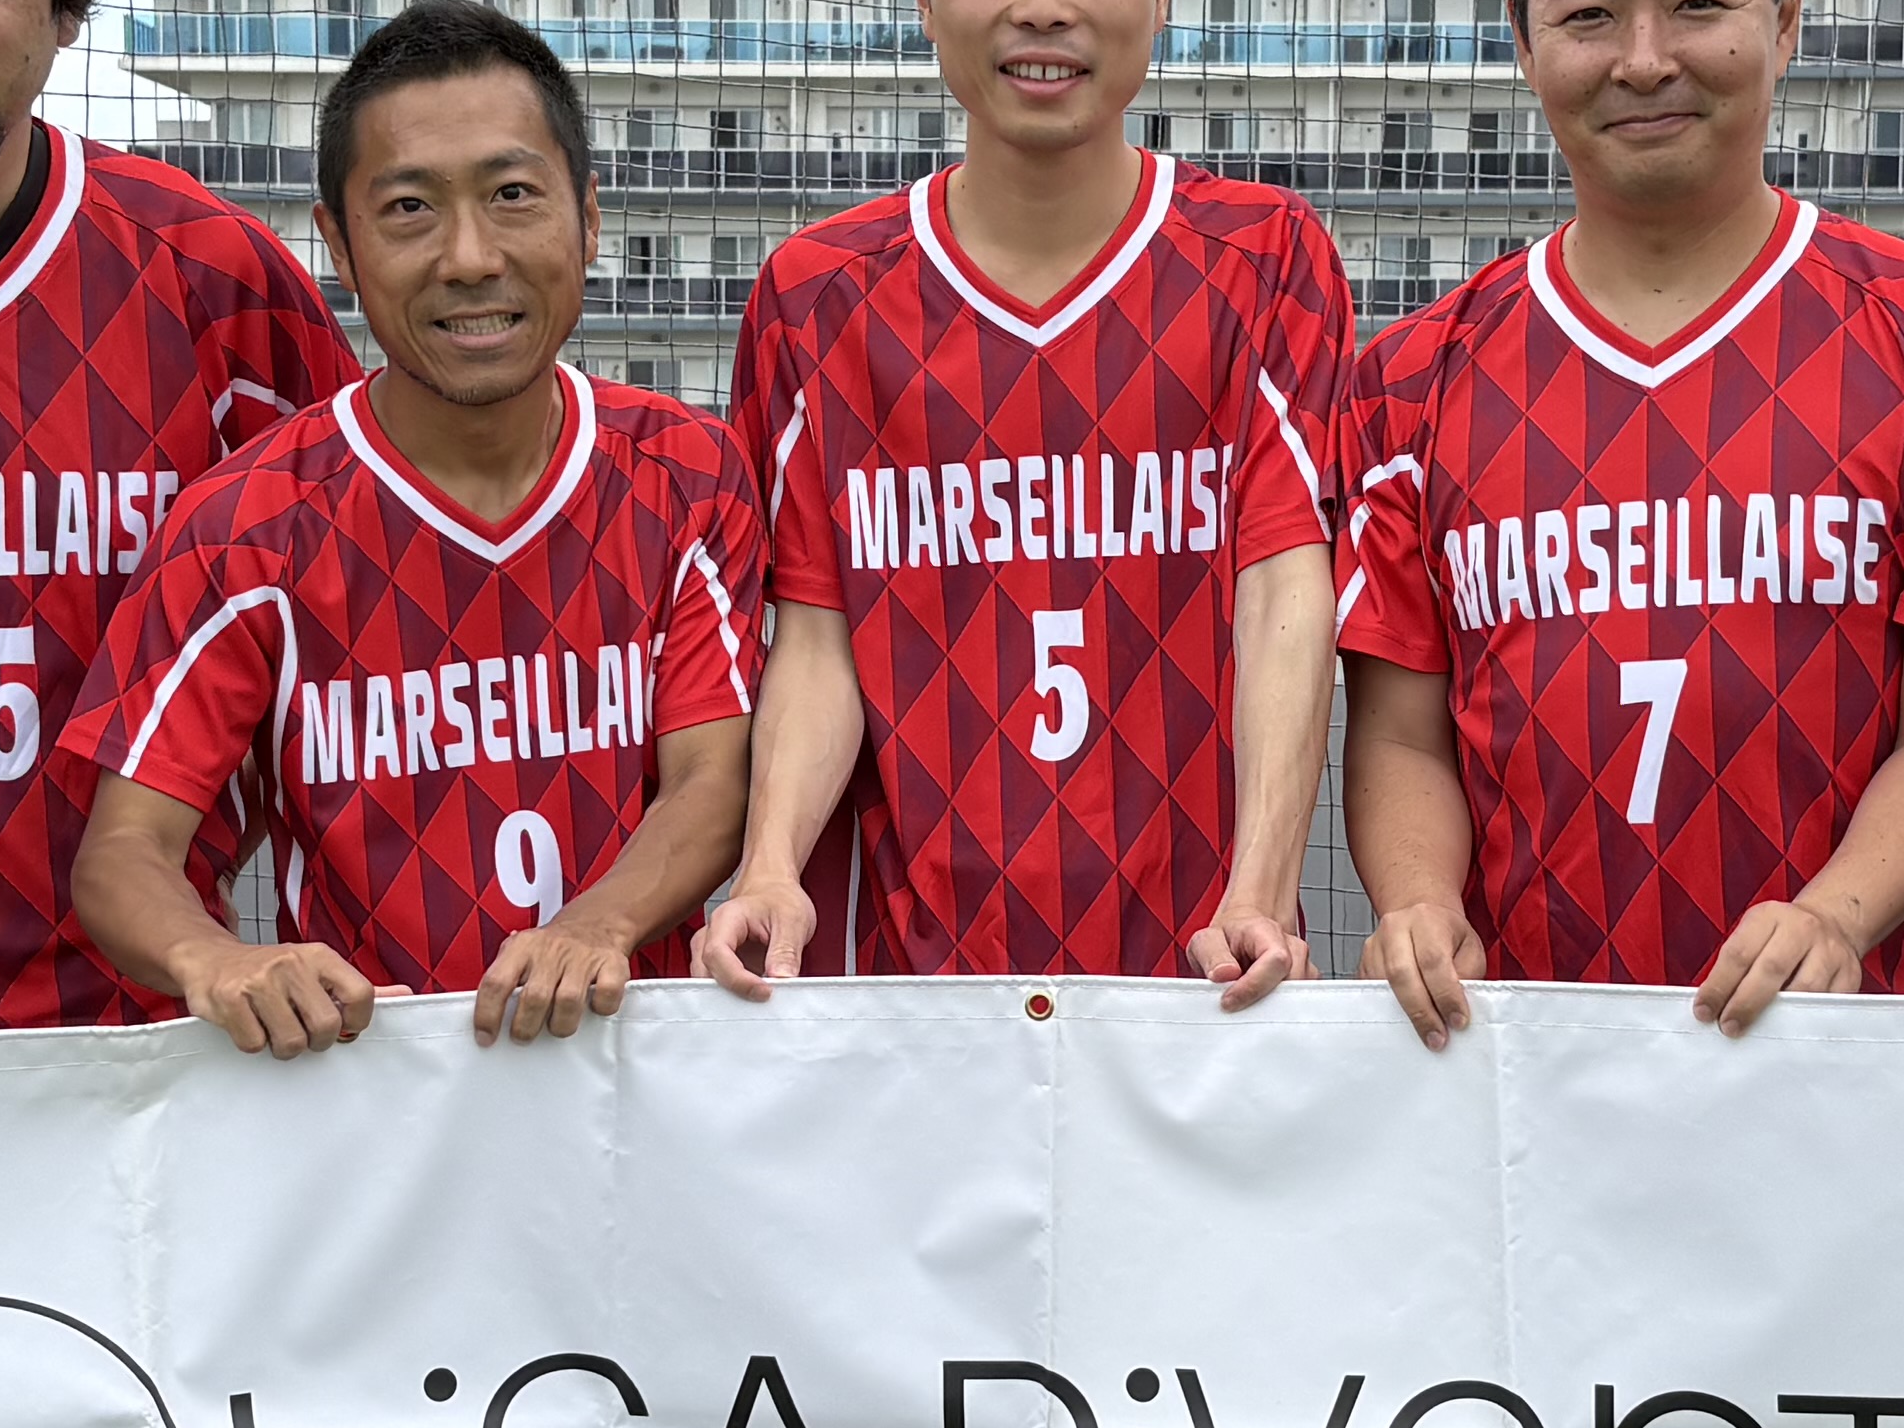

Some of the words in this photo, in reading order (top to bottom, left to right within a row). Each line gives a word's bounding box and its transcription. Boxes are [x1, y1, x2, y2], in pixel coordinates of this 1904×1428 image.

[1444, 493, 1886, 630] MARSEILLAISE
[1030, 609, 1089, 761] 5
[1620, 659, 1688, 824] 7
[495, 810, 562, 925] 9
